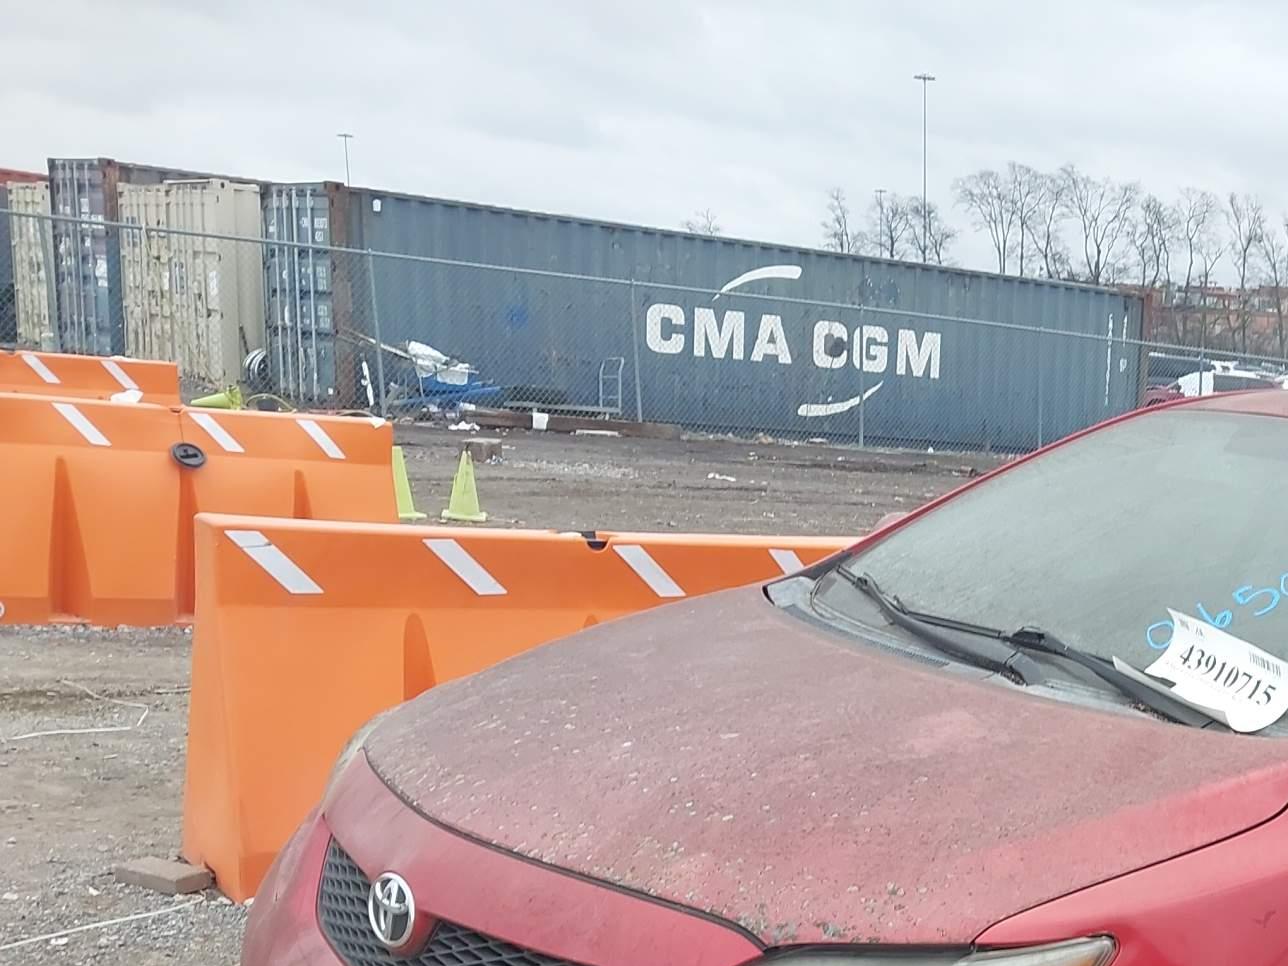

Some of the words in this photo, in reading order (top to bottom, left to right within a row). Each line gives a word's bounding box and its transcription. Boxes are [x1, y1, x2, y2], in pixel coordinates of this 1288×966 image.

[645, 303, 792, 364] CMA
[812, 319, 941, 379] CGM
[1179, 644, 1277, 706] 43910715
